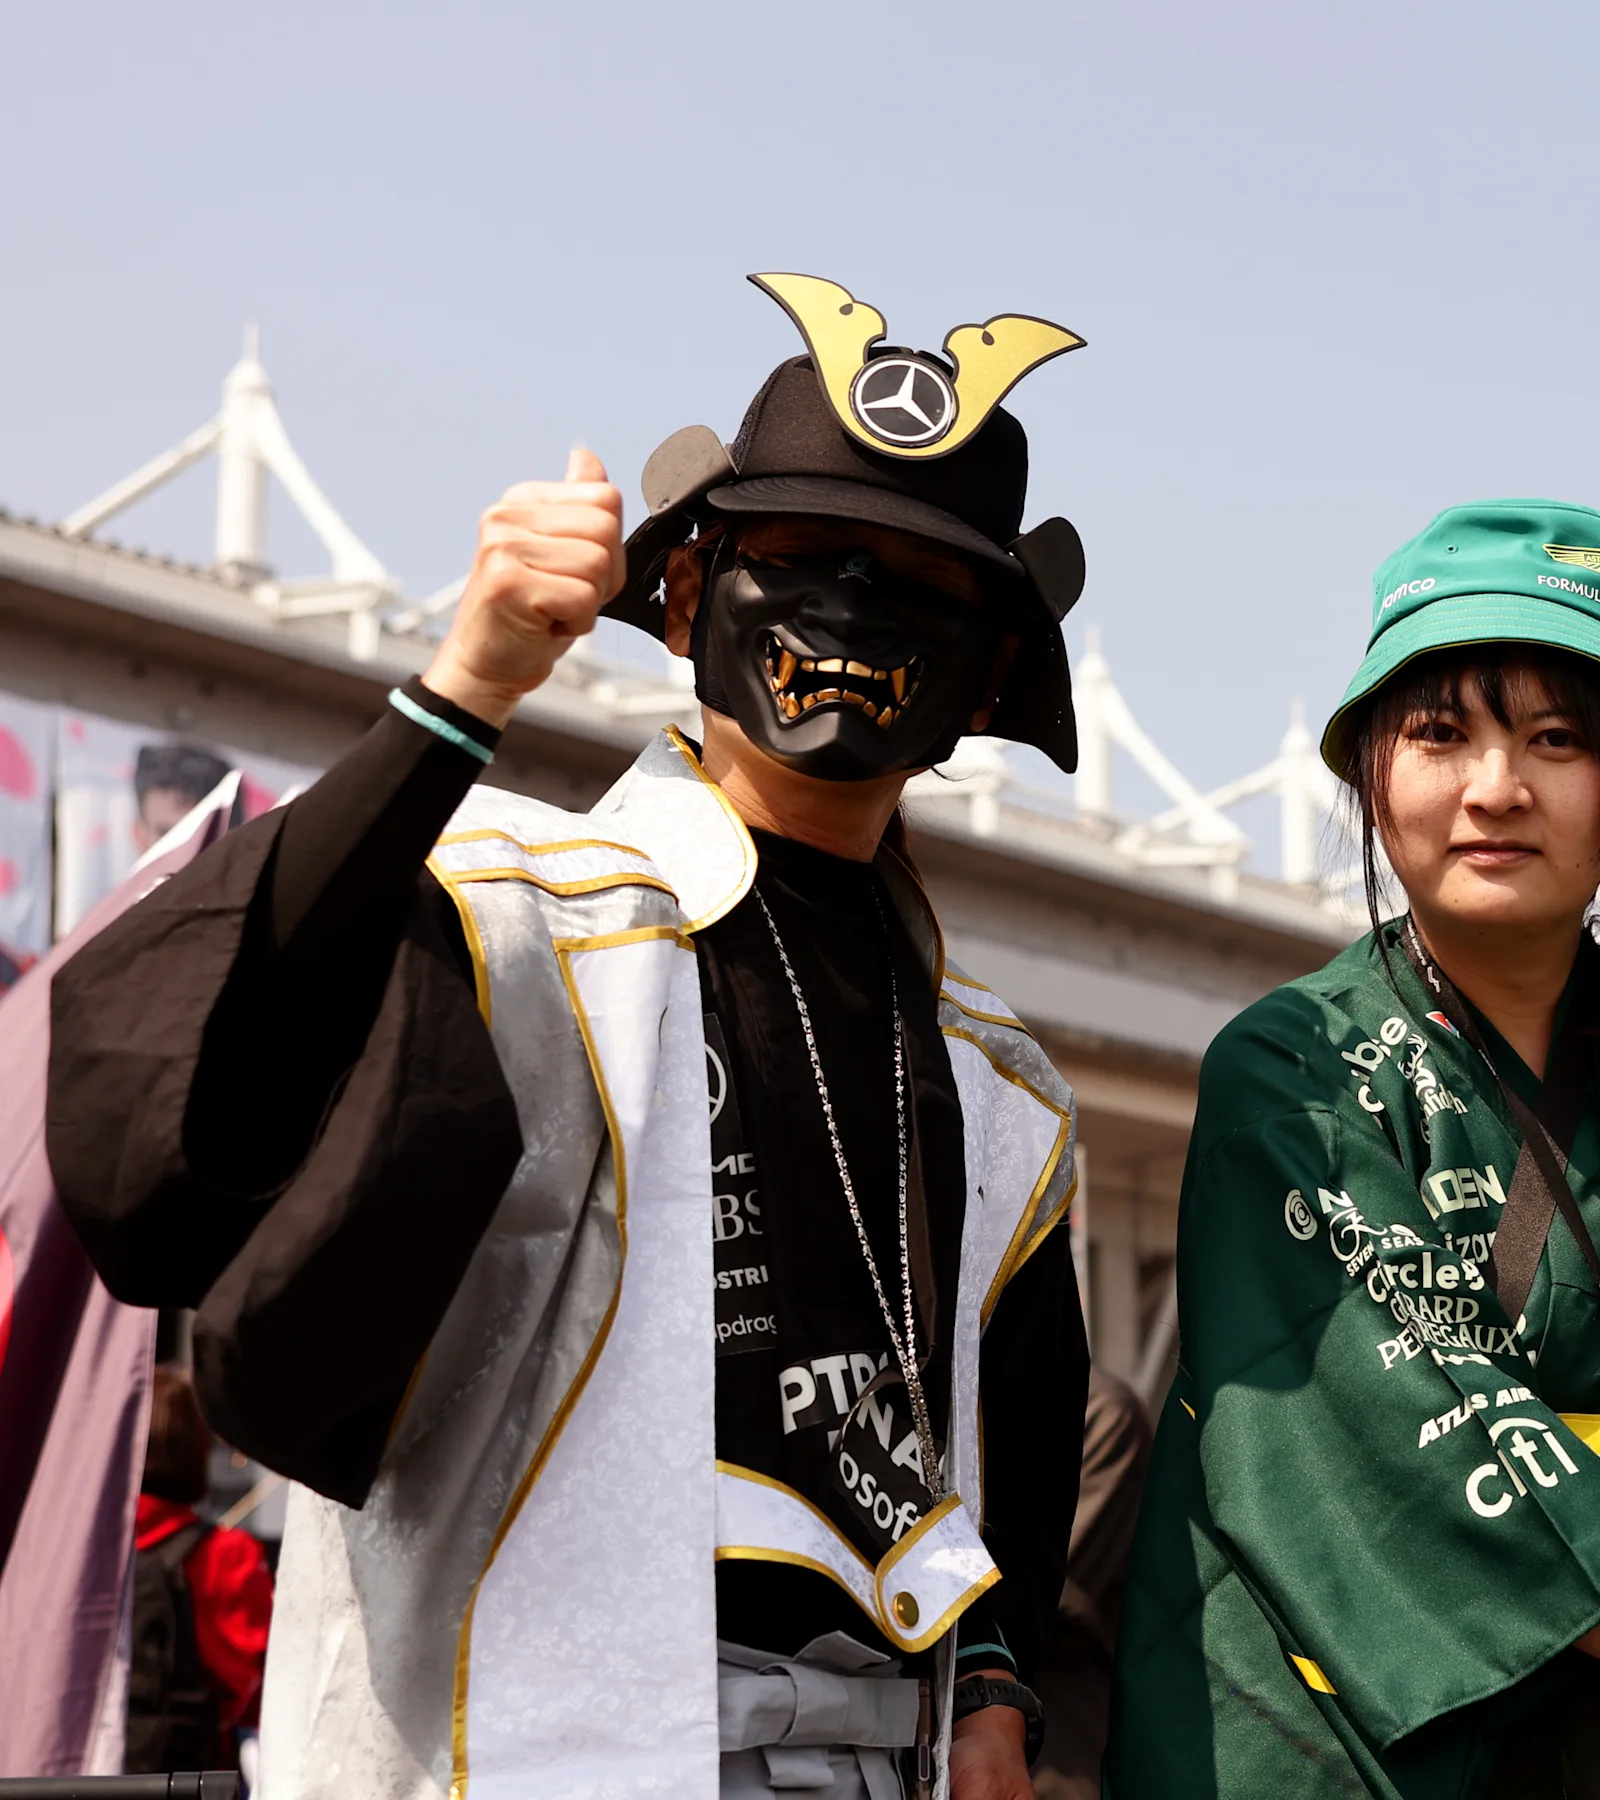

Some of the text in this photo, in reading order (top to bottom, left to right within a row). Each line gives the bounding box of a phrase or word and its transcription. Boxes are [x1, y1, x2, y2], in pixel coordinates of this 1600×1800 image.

[1345, 1236, 1424, 1278] SEVEN SEAS
[1495, 1386, 1540, 1408] AIR
[1465, 1416, 1580, 1519] citi
